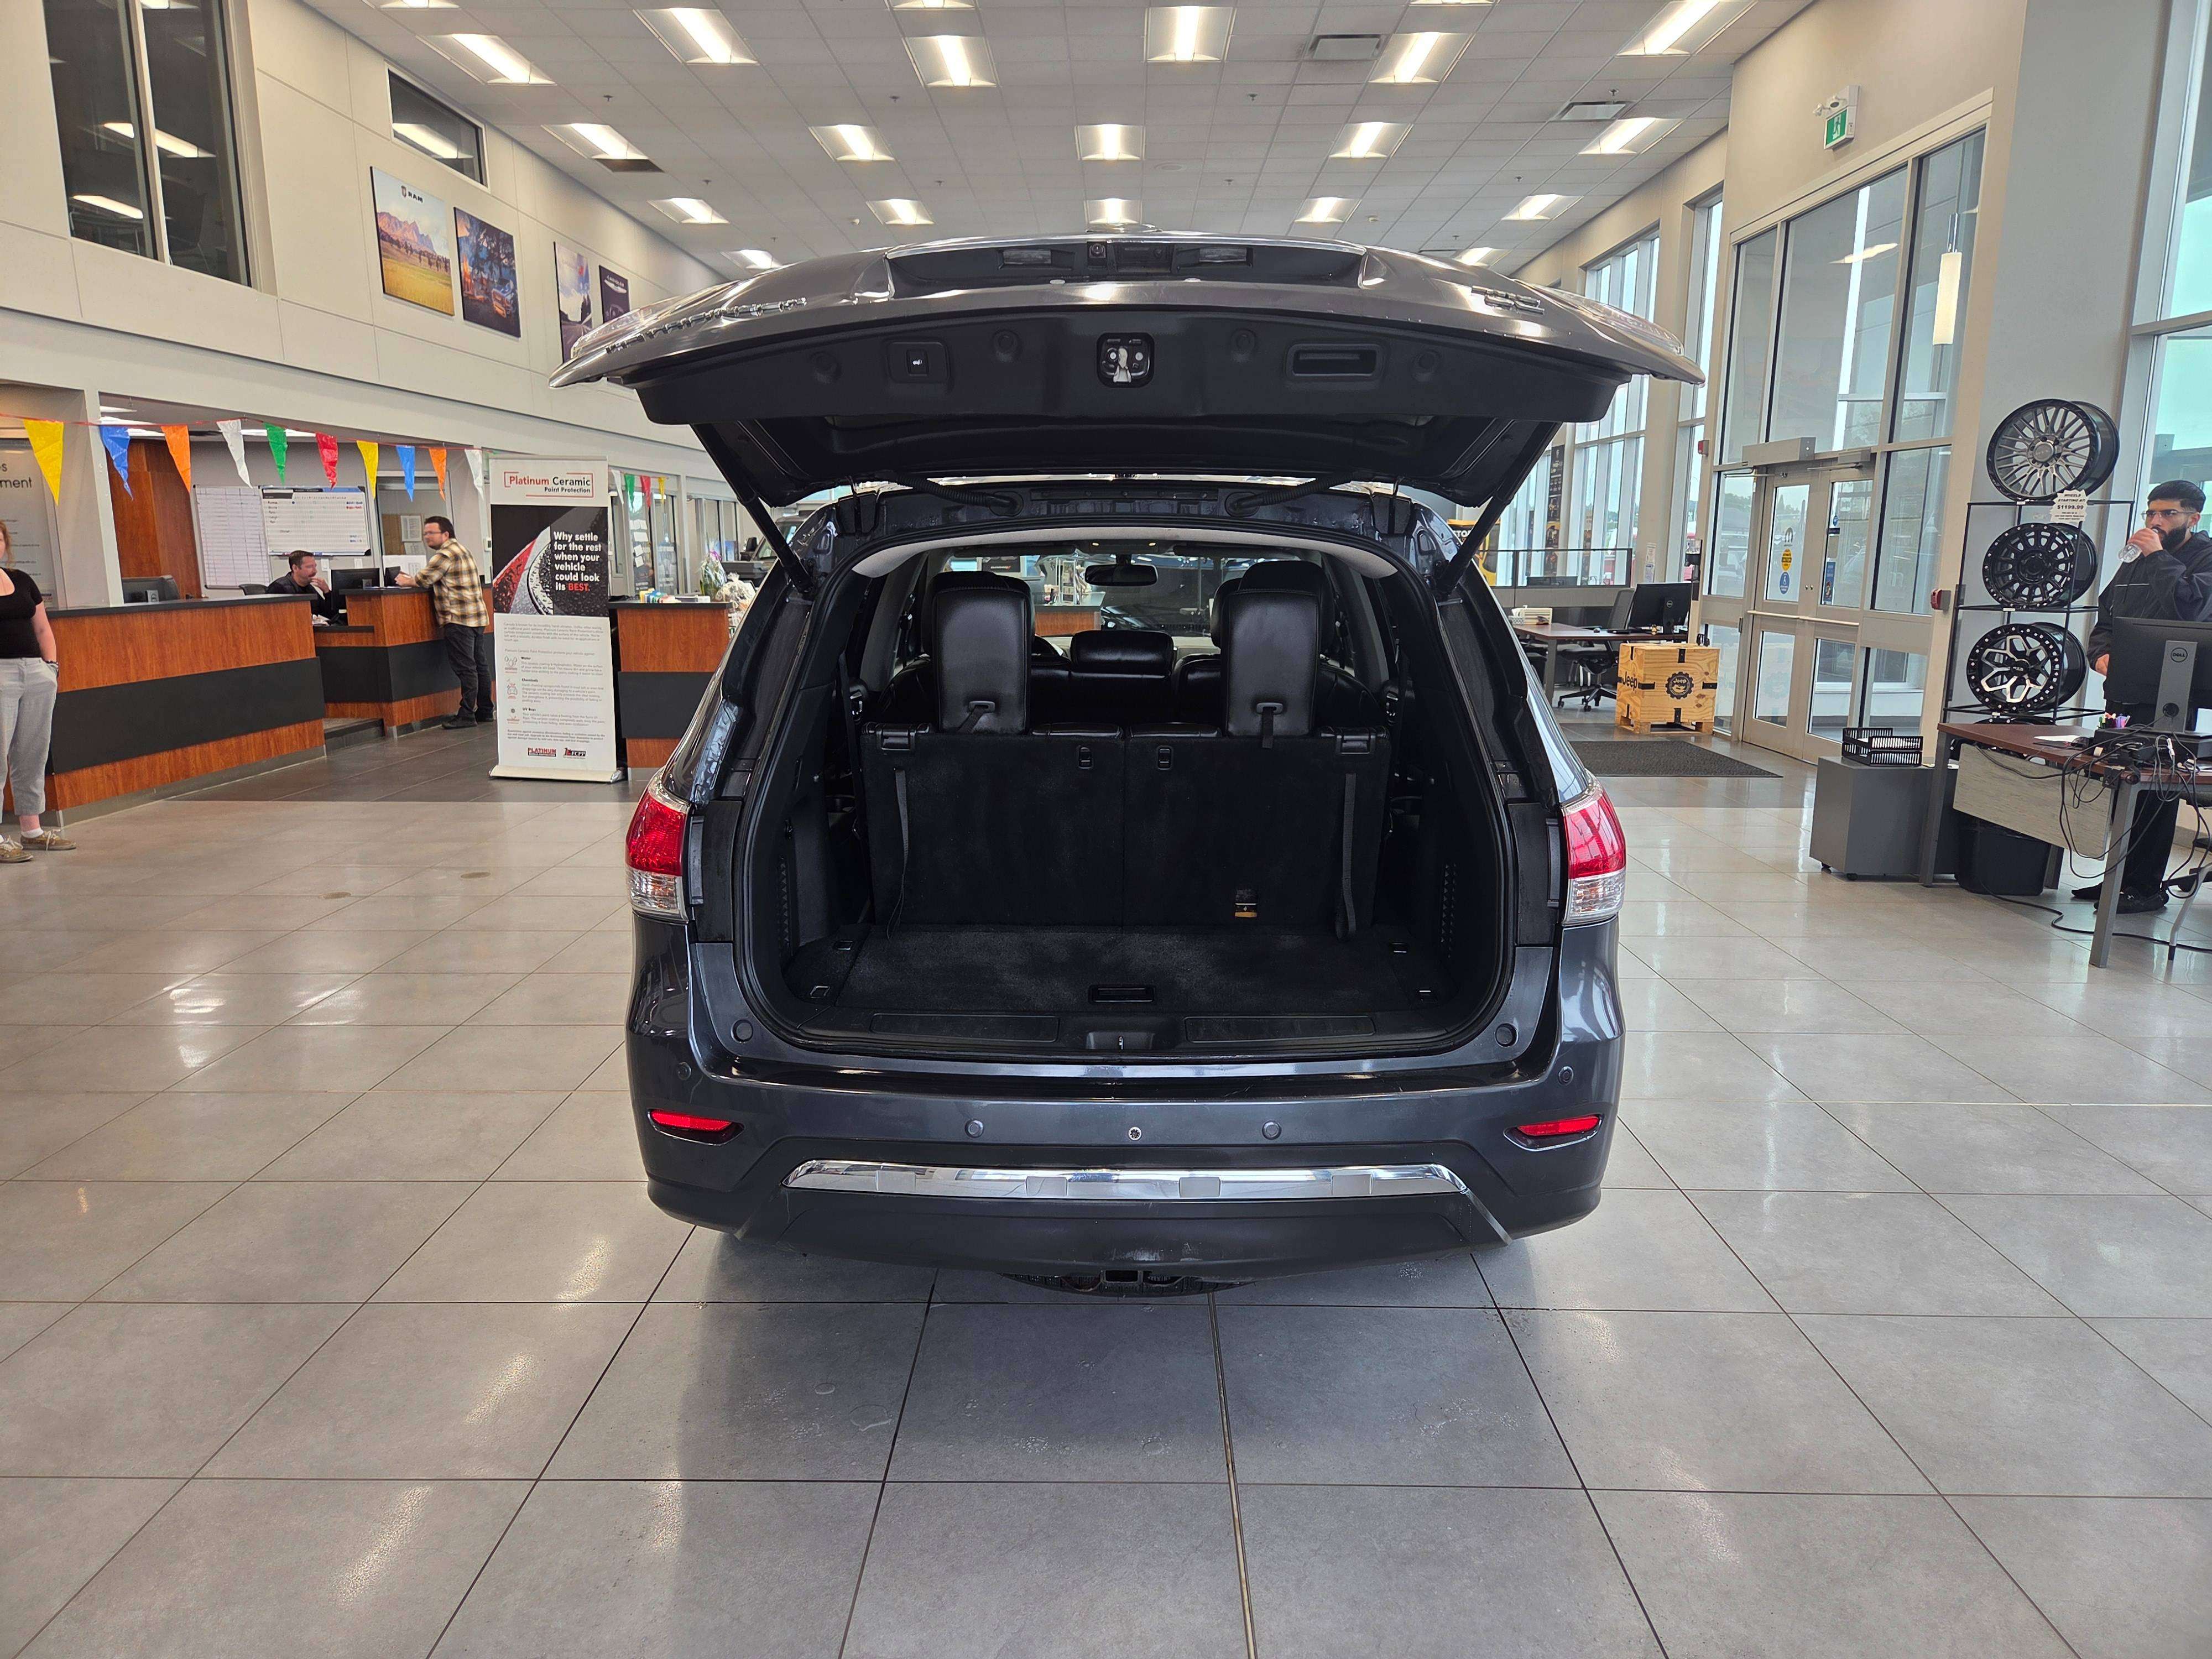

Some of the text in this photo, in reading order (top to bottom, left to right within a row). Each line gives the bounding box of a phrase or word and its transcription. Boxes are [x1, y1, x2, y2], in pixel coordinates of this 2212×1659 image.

[408, 191, 423, 203] RAM
[509, 476, 591, 486] Platinum Ceramic
[554, 531, 598, 542] Why settle
[554, 541, 602, 551] for the rest
[554, 551, 600, 563] when your
[555, 561, 586, 571] vehicle
[555, 572, 600, 582] could look
[568, 583, 590, 592] BEST.
[1621, 671, 1637, 691] Jeep
